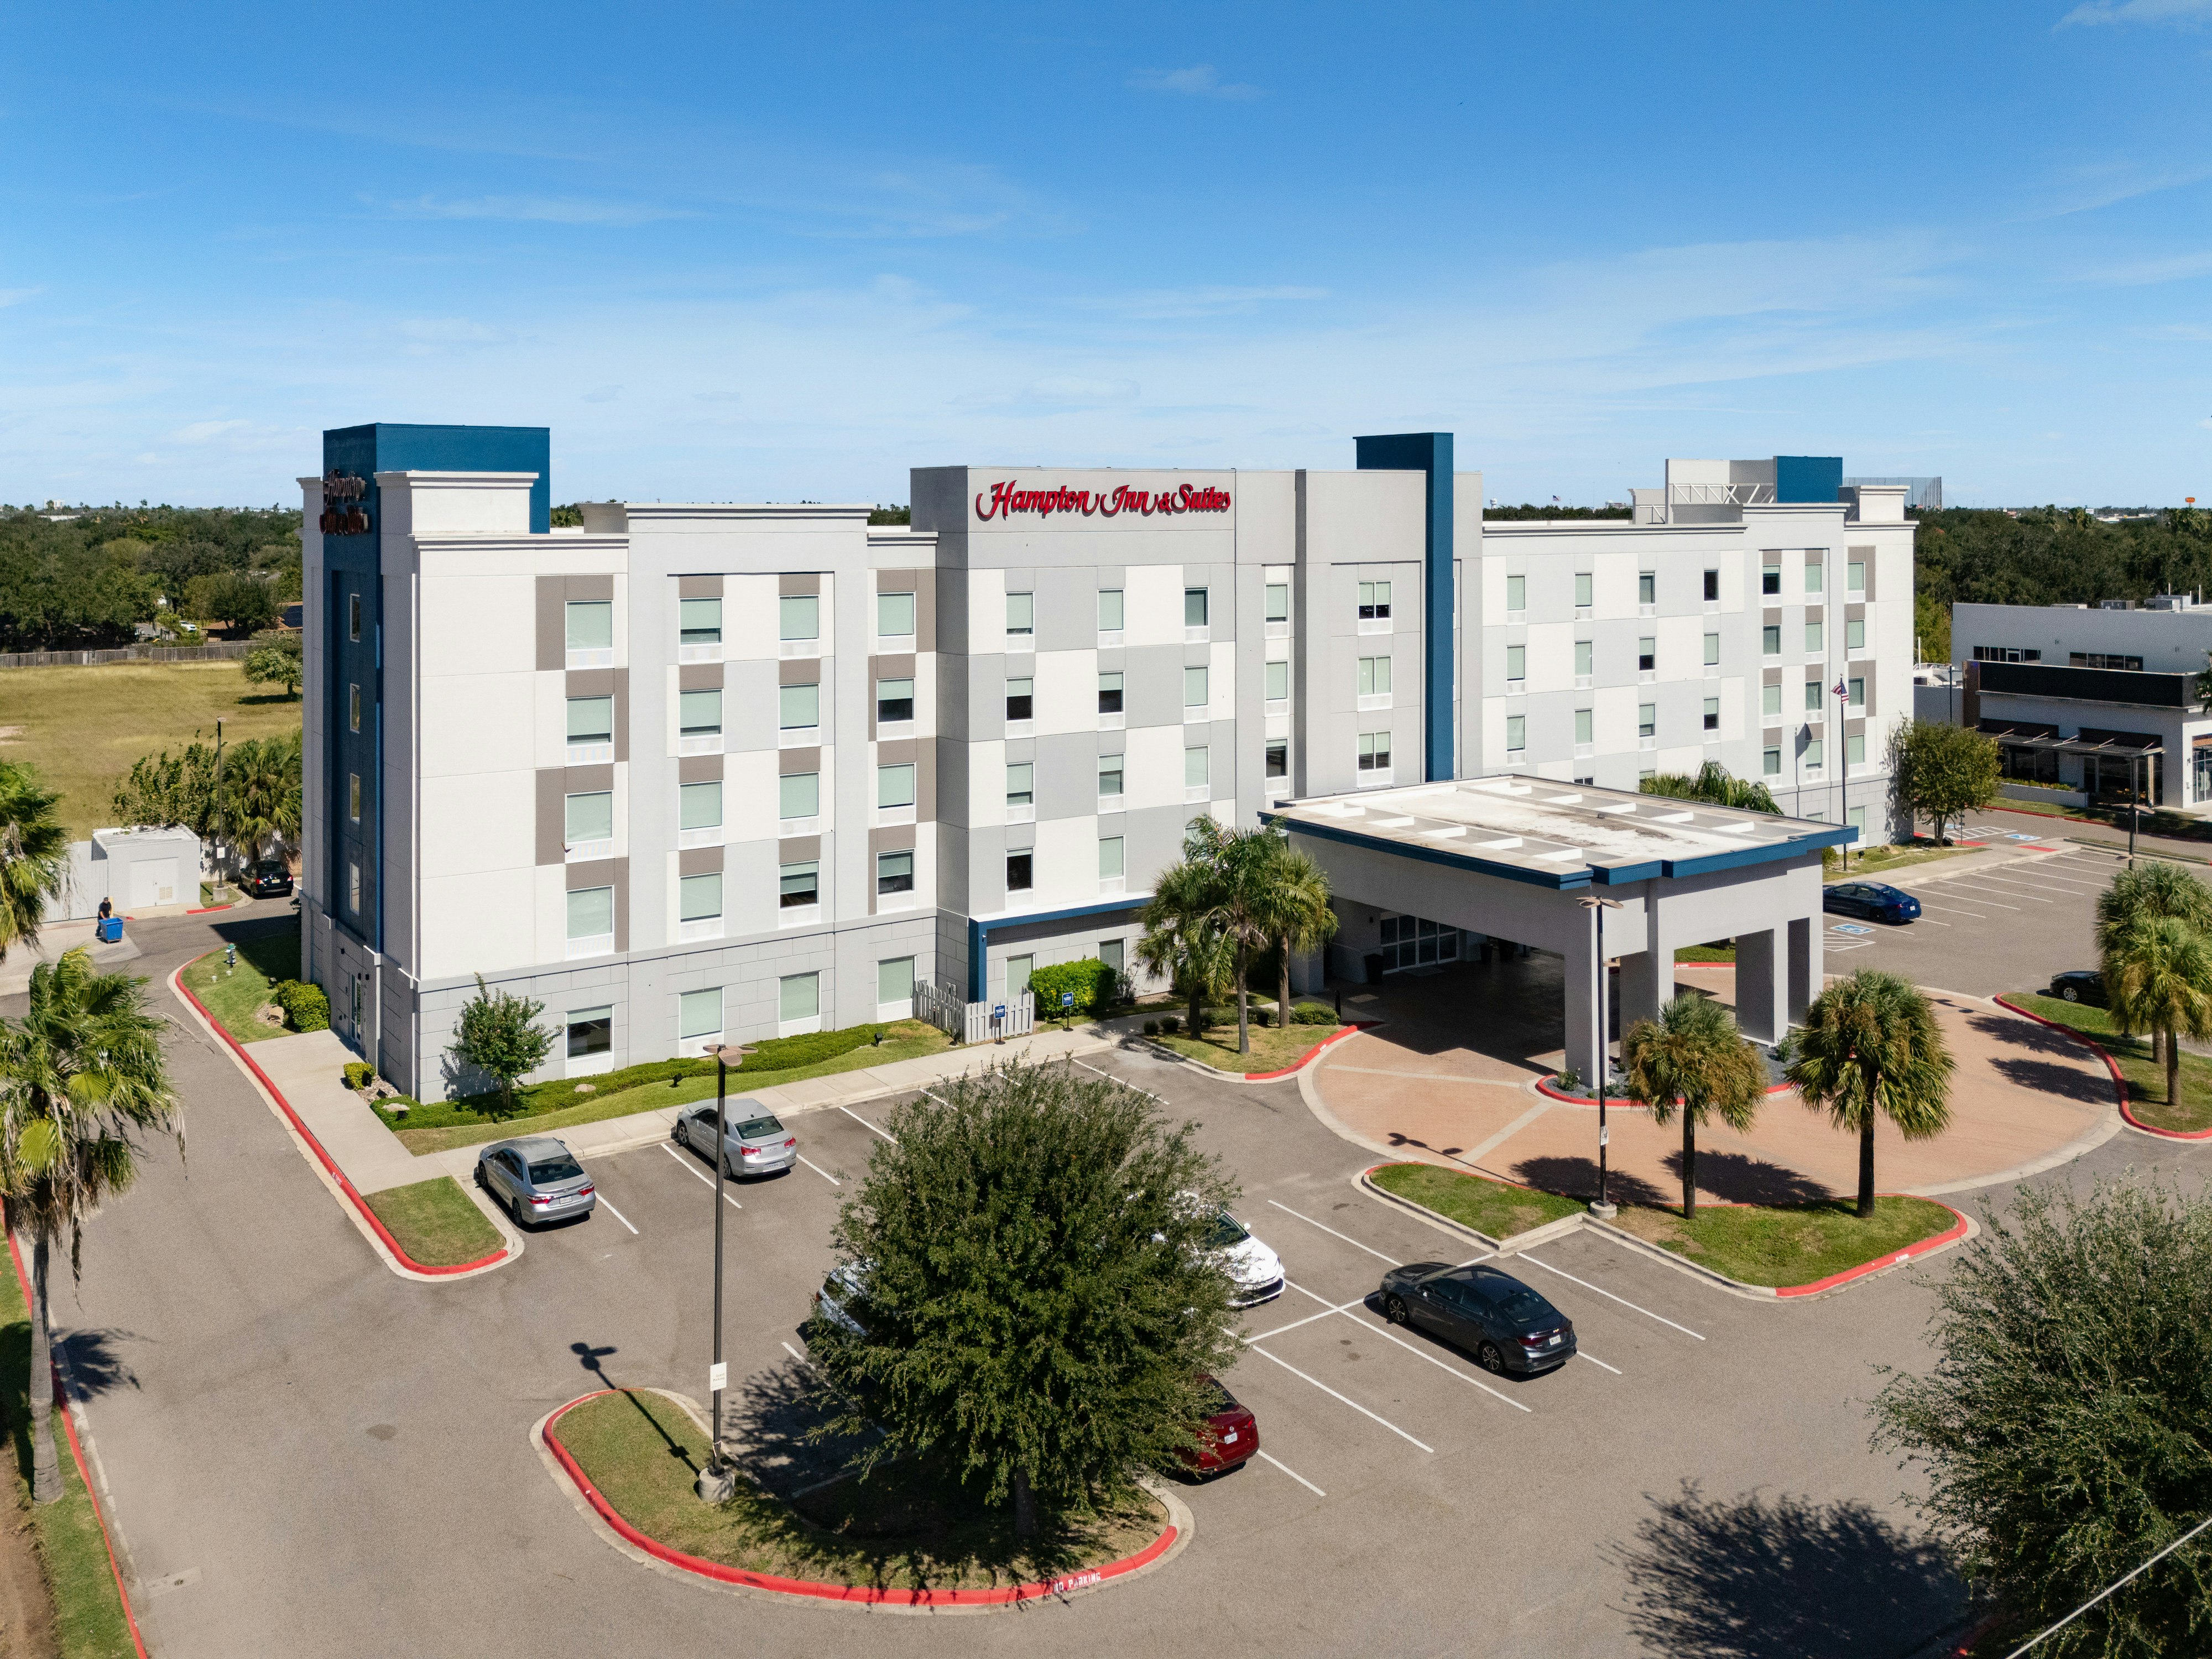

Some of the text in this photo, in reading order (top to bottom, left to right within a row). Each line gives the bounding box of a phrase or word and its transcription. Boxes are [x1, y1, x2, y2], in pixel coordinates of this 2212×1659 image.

[975, 479, 1230, 519] Hampton Inn & Suites
[1053, 1572, 1101, 1592] NO PARKING
